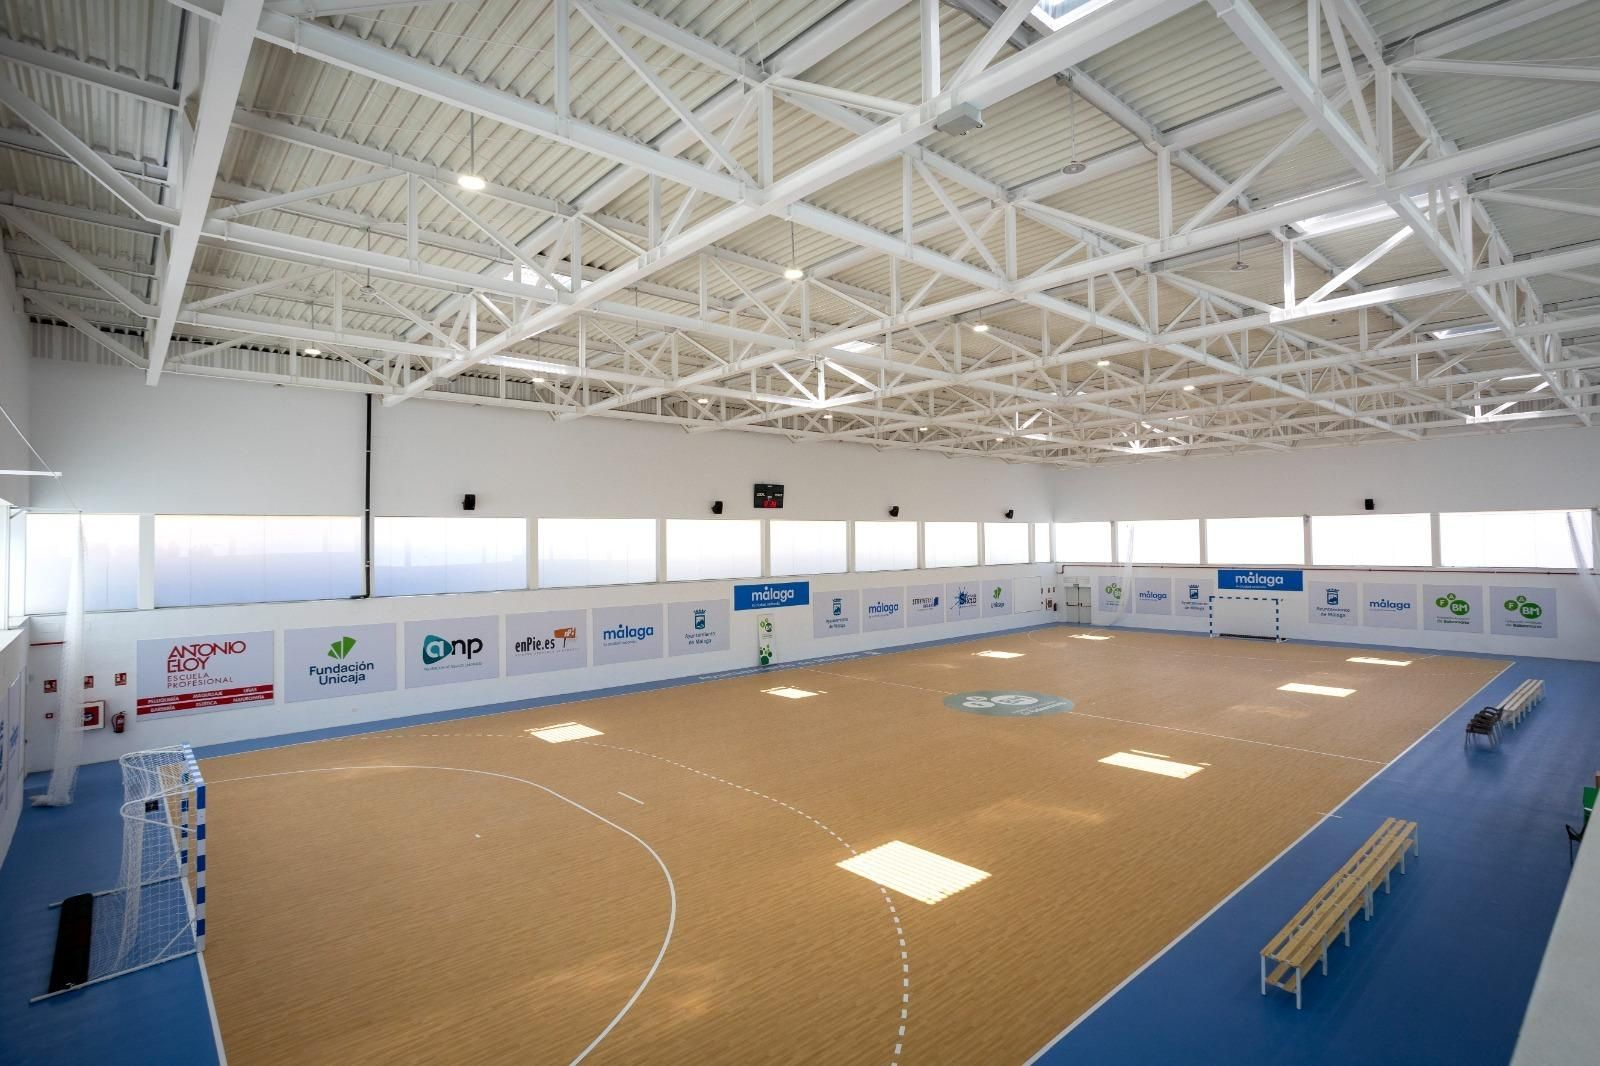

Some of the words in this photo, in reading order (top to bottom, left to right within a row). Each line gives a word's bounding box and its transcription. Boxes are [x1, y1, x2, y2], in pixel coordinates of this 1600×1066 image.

[1451, 603, 1468, 613] BM
[1522, 606, 1540, 616] BM
[168, 640, 247, 660] ANTONIO
[515, 636, 556, 653] enPie.es
[167, 656, 210, 674] ELOY
[309, 660, 375, 676] Fundación
[167, 672, 210, 683] ESCUELA
[167, 676, 234, 689] PROFESIONAL
[318, 671, 366, 686] Unicaja
